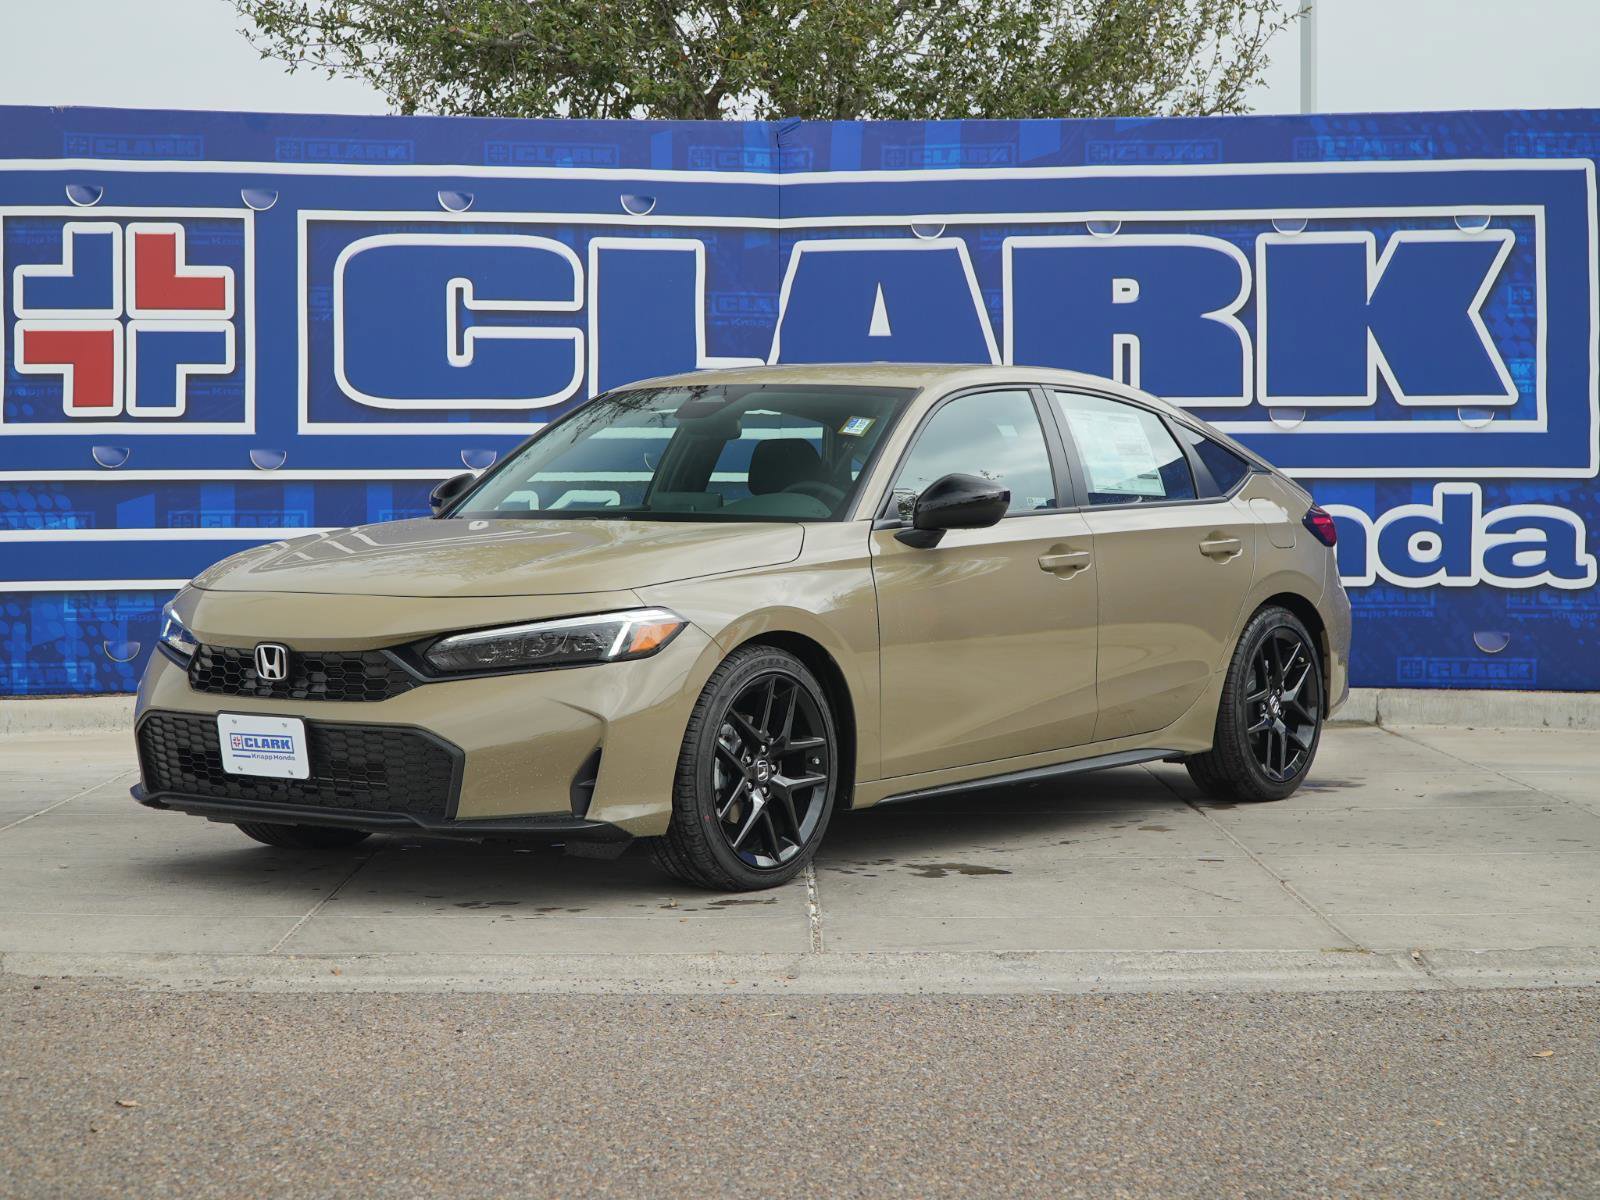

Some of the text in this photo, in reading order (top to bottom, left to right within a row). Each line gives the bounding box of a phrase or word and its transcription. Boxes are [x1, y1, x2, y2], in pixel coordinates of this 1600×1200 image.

[95, 139, 198, 154] CLARK
[307, 143, 407, 160] CLARK
[514, 147, 615, 163] CLARK
[333, 228, 1519, 409] CLARK
[1335, 482, 1597, 590] nda
[1430, 662, 1530, 678] CLARK
[244, 737, 290, 750] CLARK
[251, 753, 273, 761] Knapp
